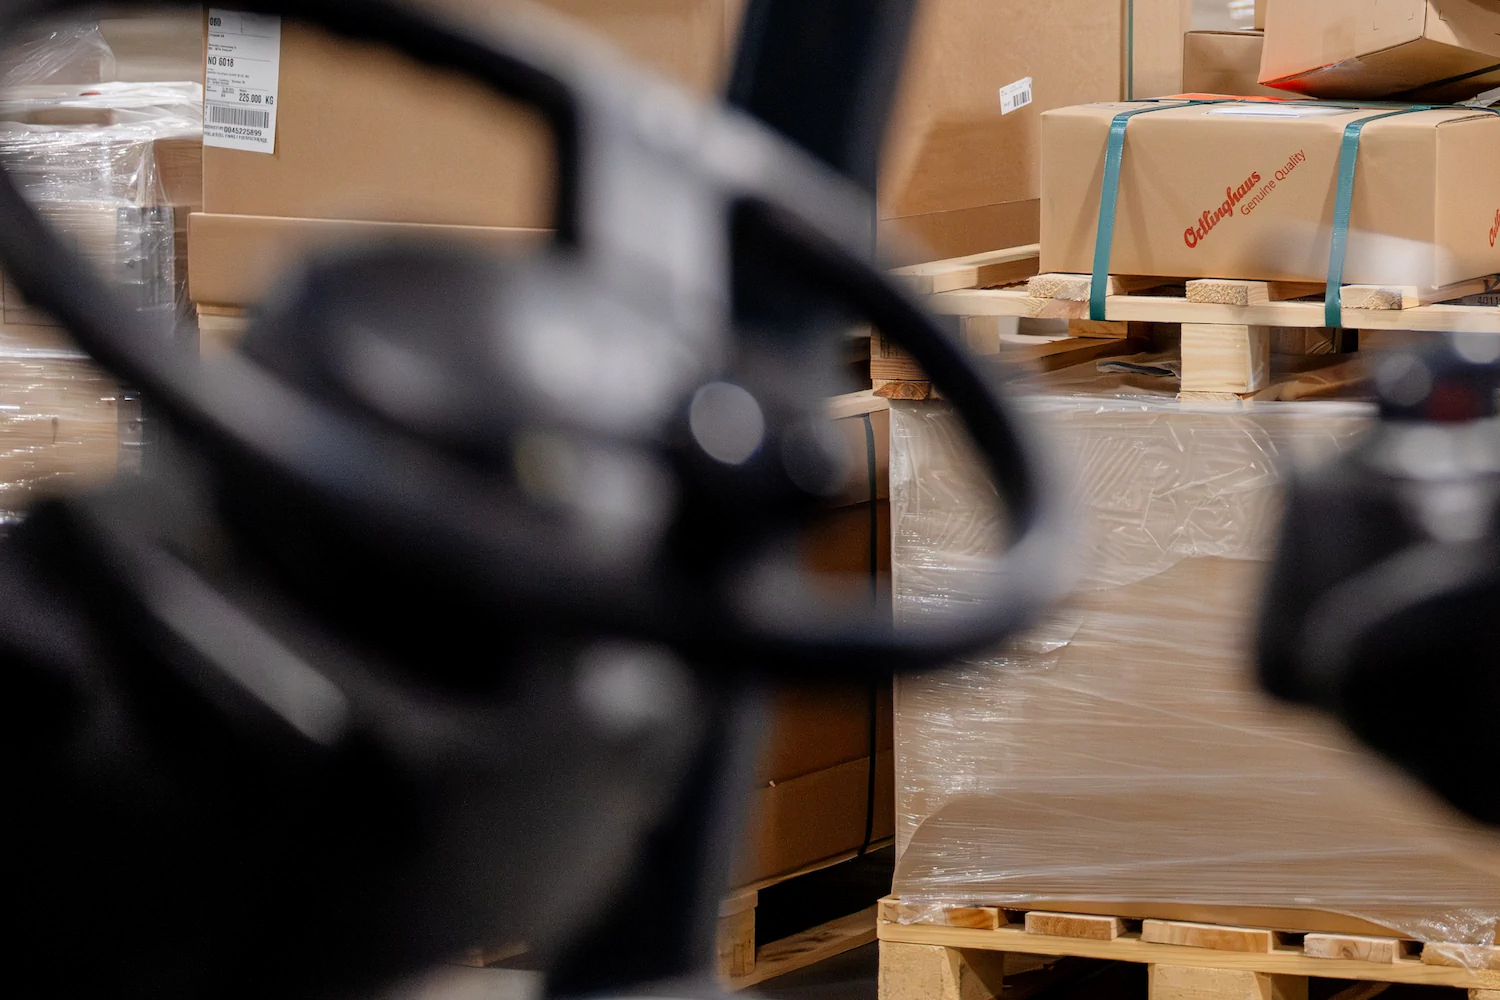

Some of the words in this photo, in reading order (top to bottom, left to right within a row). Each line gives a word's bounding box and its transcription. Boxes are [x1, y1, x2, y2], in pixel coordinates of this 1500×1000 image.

[208, 56, 217, 66] NO
[219, 57, 234, 68] 6018
[265, 95, 274, 105] KG
[1240, 179, 1276, 215] Genuine
[1274, 149, 1306, 181] Quality
